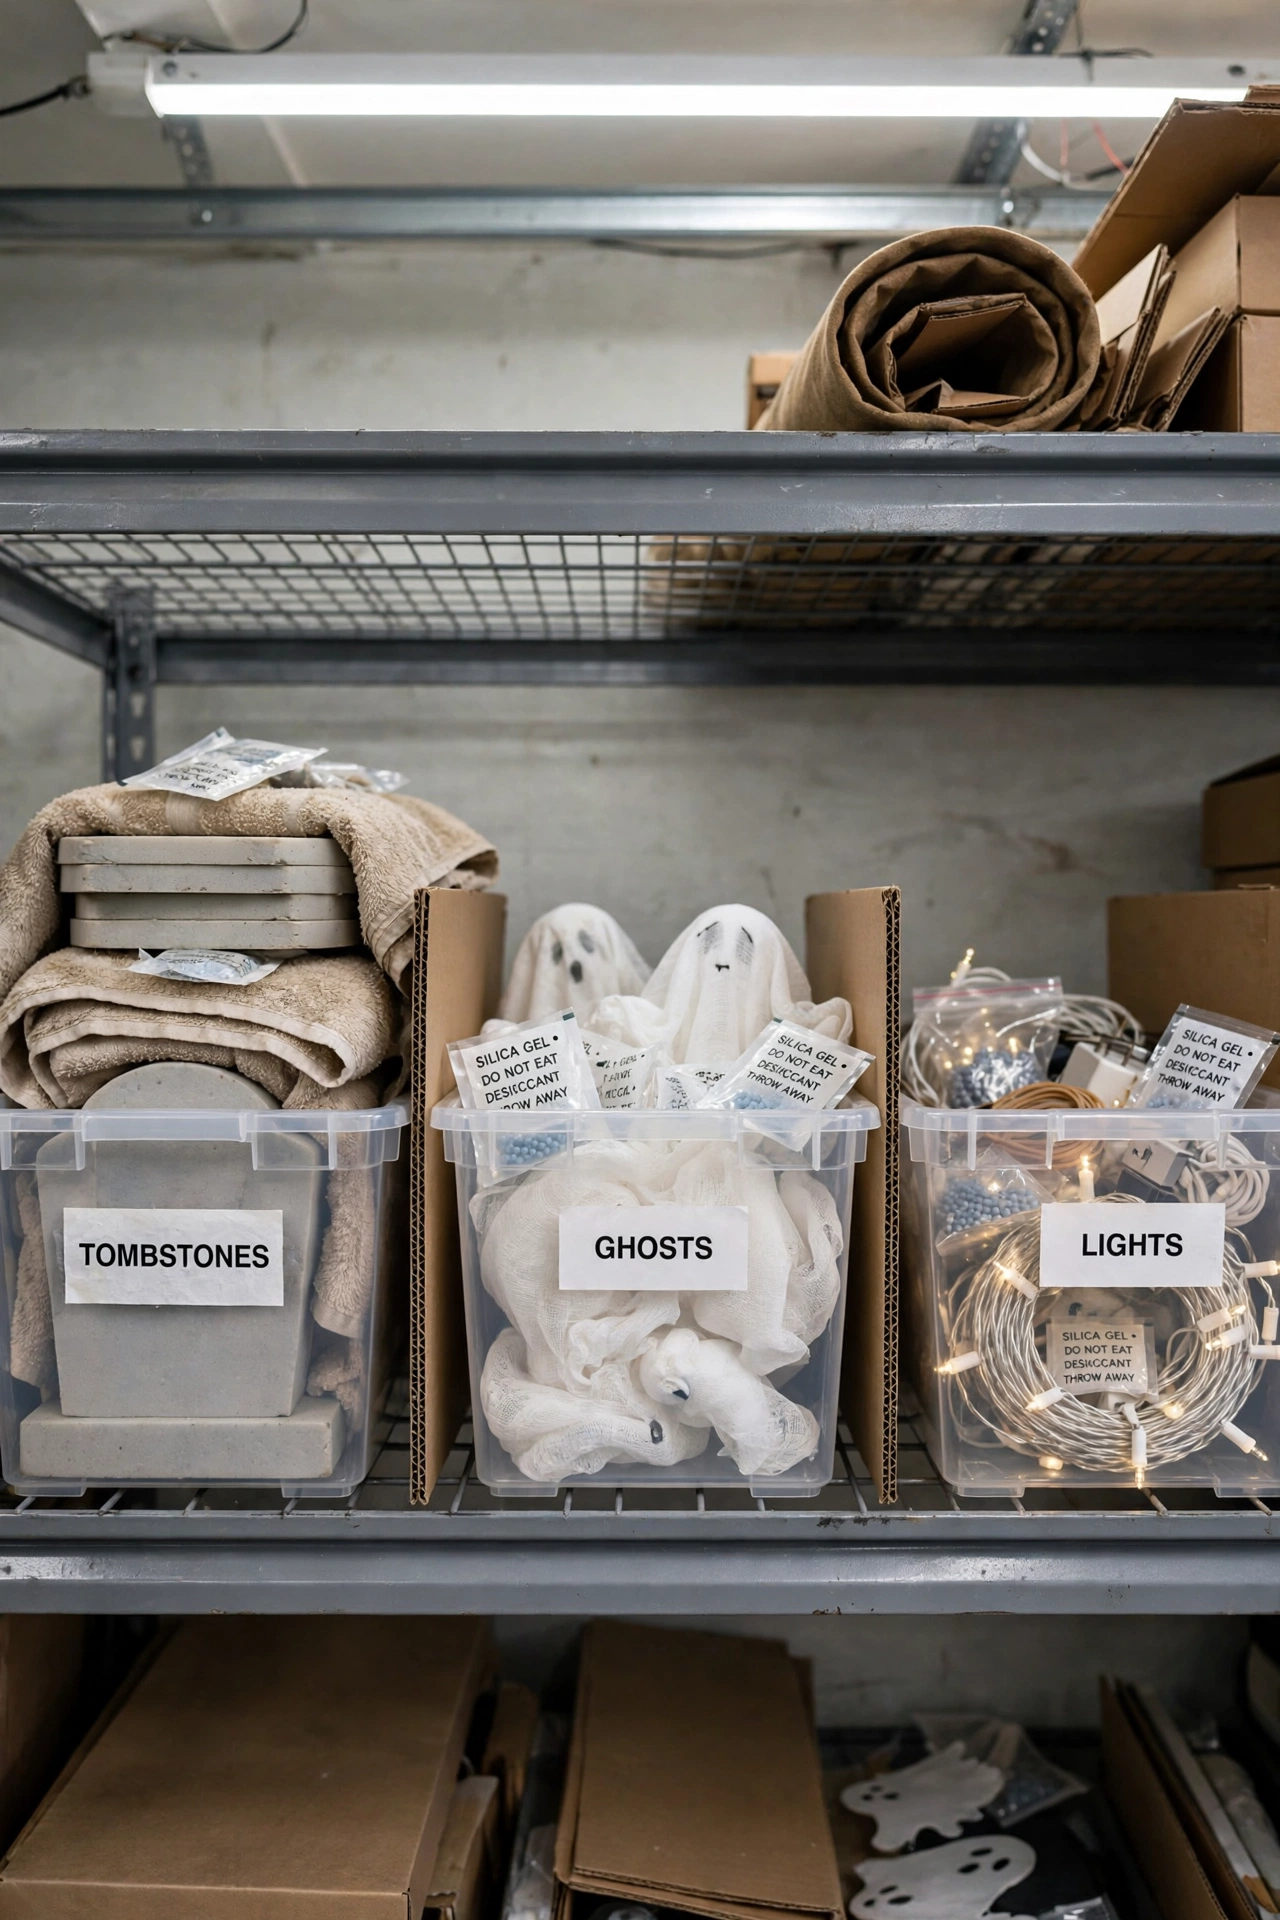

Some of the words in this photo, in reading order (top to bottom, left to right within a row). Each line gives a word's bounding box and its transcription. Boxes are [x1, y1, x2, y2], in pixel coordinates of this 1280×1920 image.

[475, 1045, 520, 1069] SILICA
[523, 1036, 551, 1053] GEL
[777, 1034, 813, 1056] SILICA
[815, 1051, 838, 1067] GEL
[1182, 1029, 1218, 1049] SILICA
[1221, 1041, 1243, 1057] GEL
[481, 1071, 501, 1086] DO
[504, 1060, 531, 1078] NOT
[533, 1052, 558, 1069] EAT
[767, 1047, 785, 1059] DO
[785, 1054, 811, 1069] NOT
[809, 1064, 833, 1080] EAT
[1173, 1044, 1190, 1057] DO
[1192, 1050, 1217, 1064] NOT
[1217, 1058, 1241, 1073] EAT
[535, 1086, 568, 1107] AWAY
[747, 1070, 783, 1090] THROW
[781, 1085, 814, 1104] AWAY
[1157, 1072, 1192, 1091] THROW
[1192, 1085, 1225, 1103] AWAY
[79, 1242, 270, 1269] TOMBSTONES
[594, 1235, 713, 1260] GHOSTS
[1082, 1233, 1183, 1257] LIGHTS
[1062, 1331, 1101, 1341] SILICA
[1104, 1331, 1128, 1340] GEL
[1064, 1345, 1081, 1355] DO
[1084, 1345, 1108, 1354] NOT
[1111, 1345, 1133, 1354] EAT
[1063, 1372, 1102, 1384] THROW
[1104, 1372, 1135, 1382] AWAY
